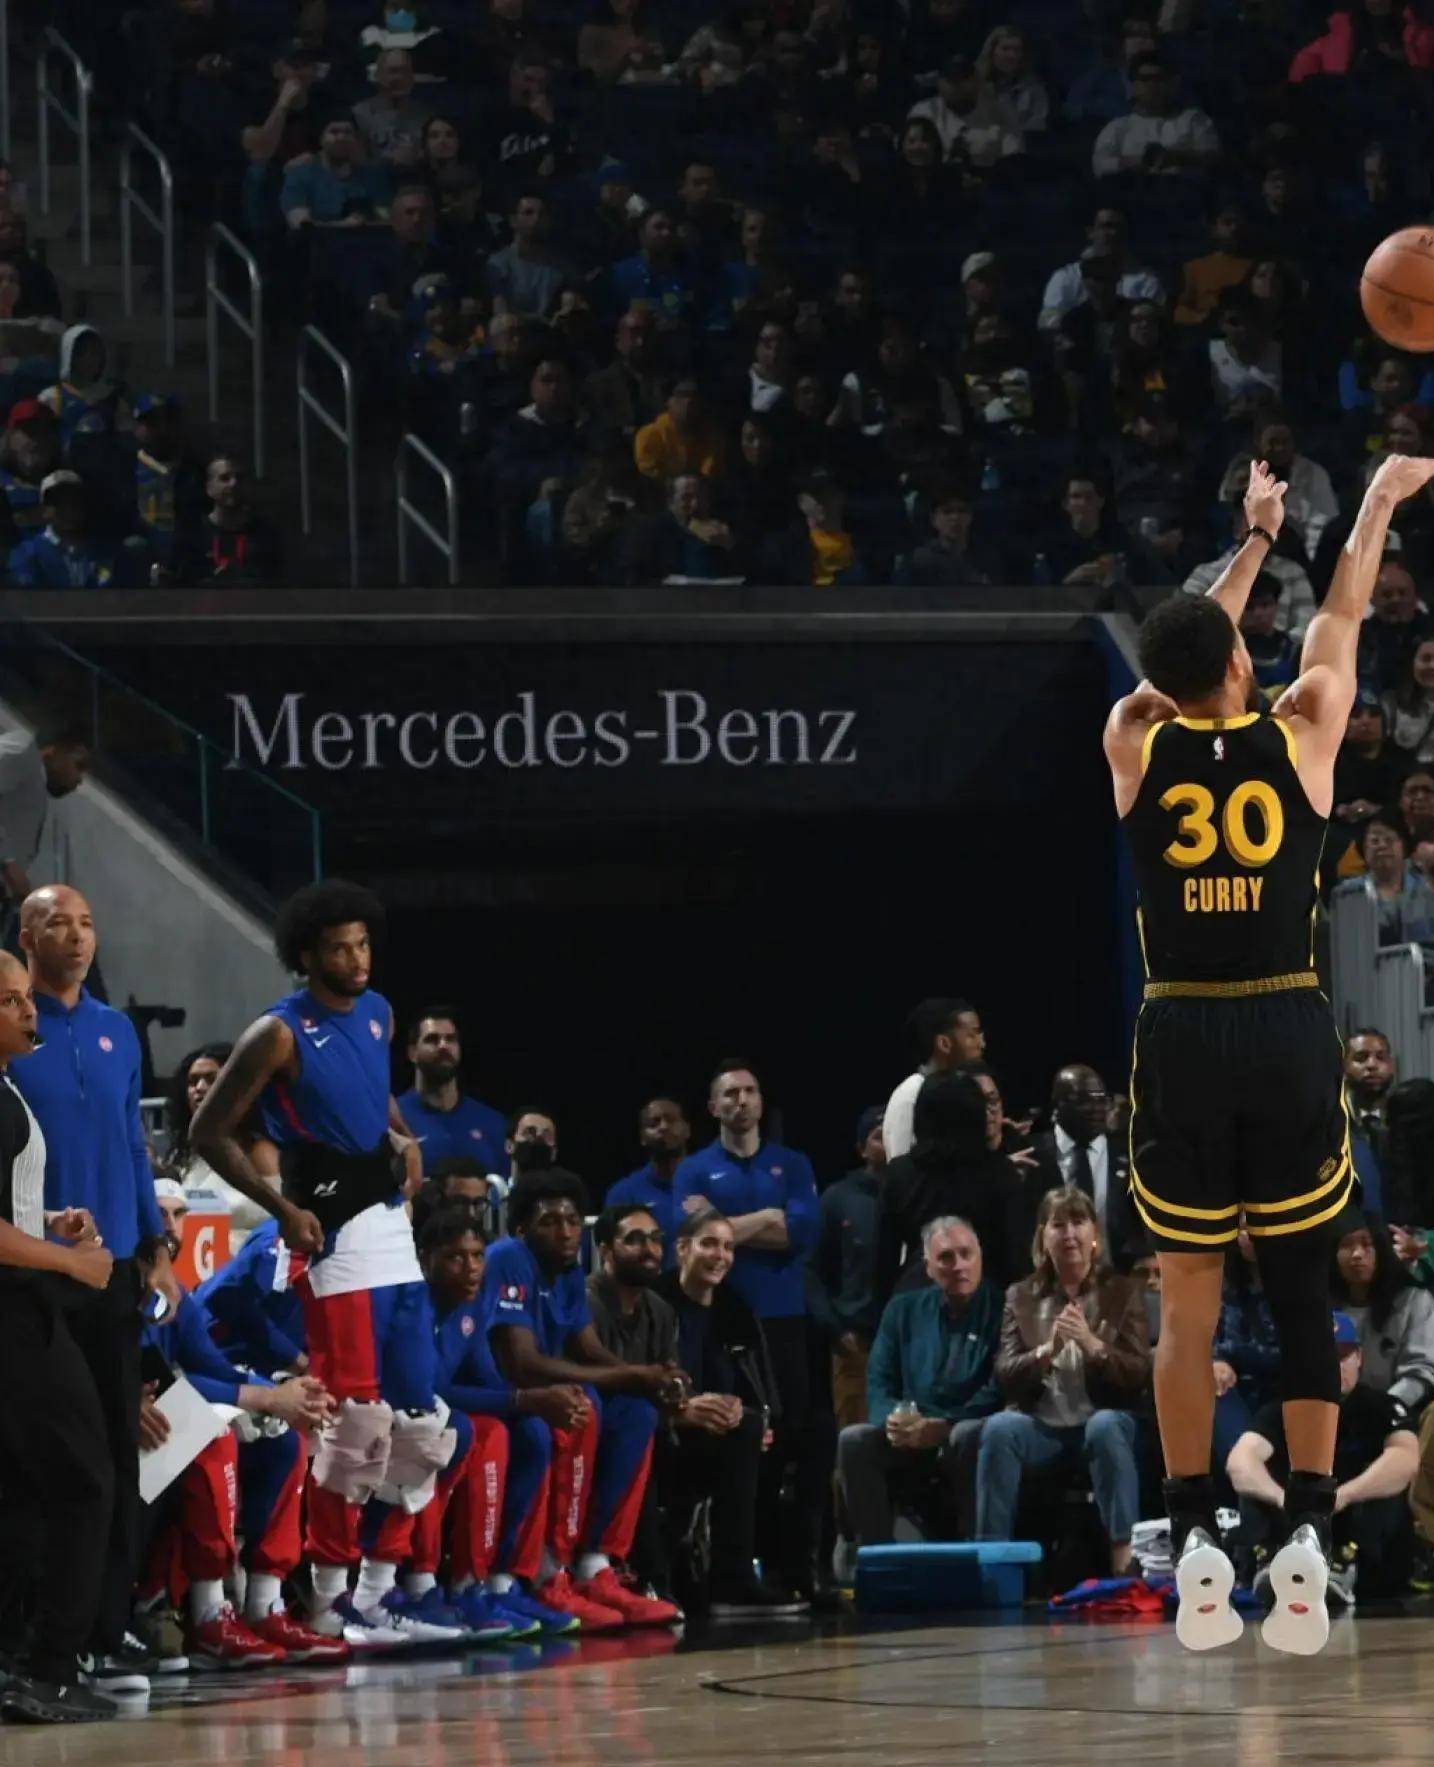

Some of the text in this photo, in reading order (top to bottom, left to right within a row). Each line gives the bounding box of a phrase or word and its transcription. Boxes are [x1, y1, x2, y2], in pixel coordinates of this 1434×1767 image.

[224, 688, 857, 770] Mercedes-Benz
[1158, 780, 1285, 869] 30
[1183, 876, 1264, 912] CURRY
[193, 1225, 216, 1284] G
